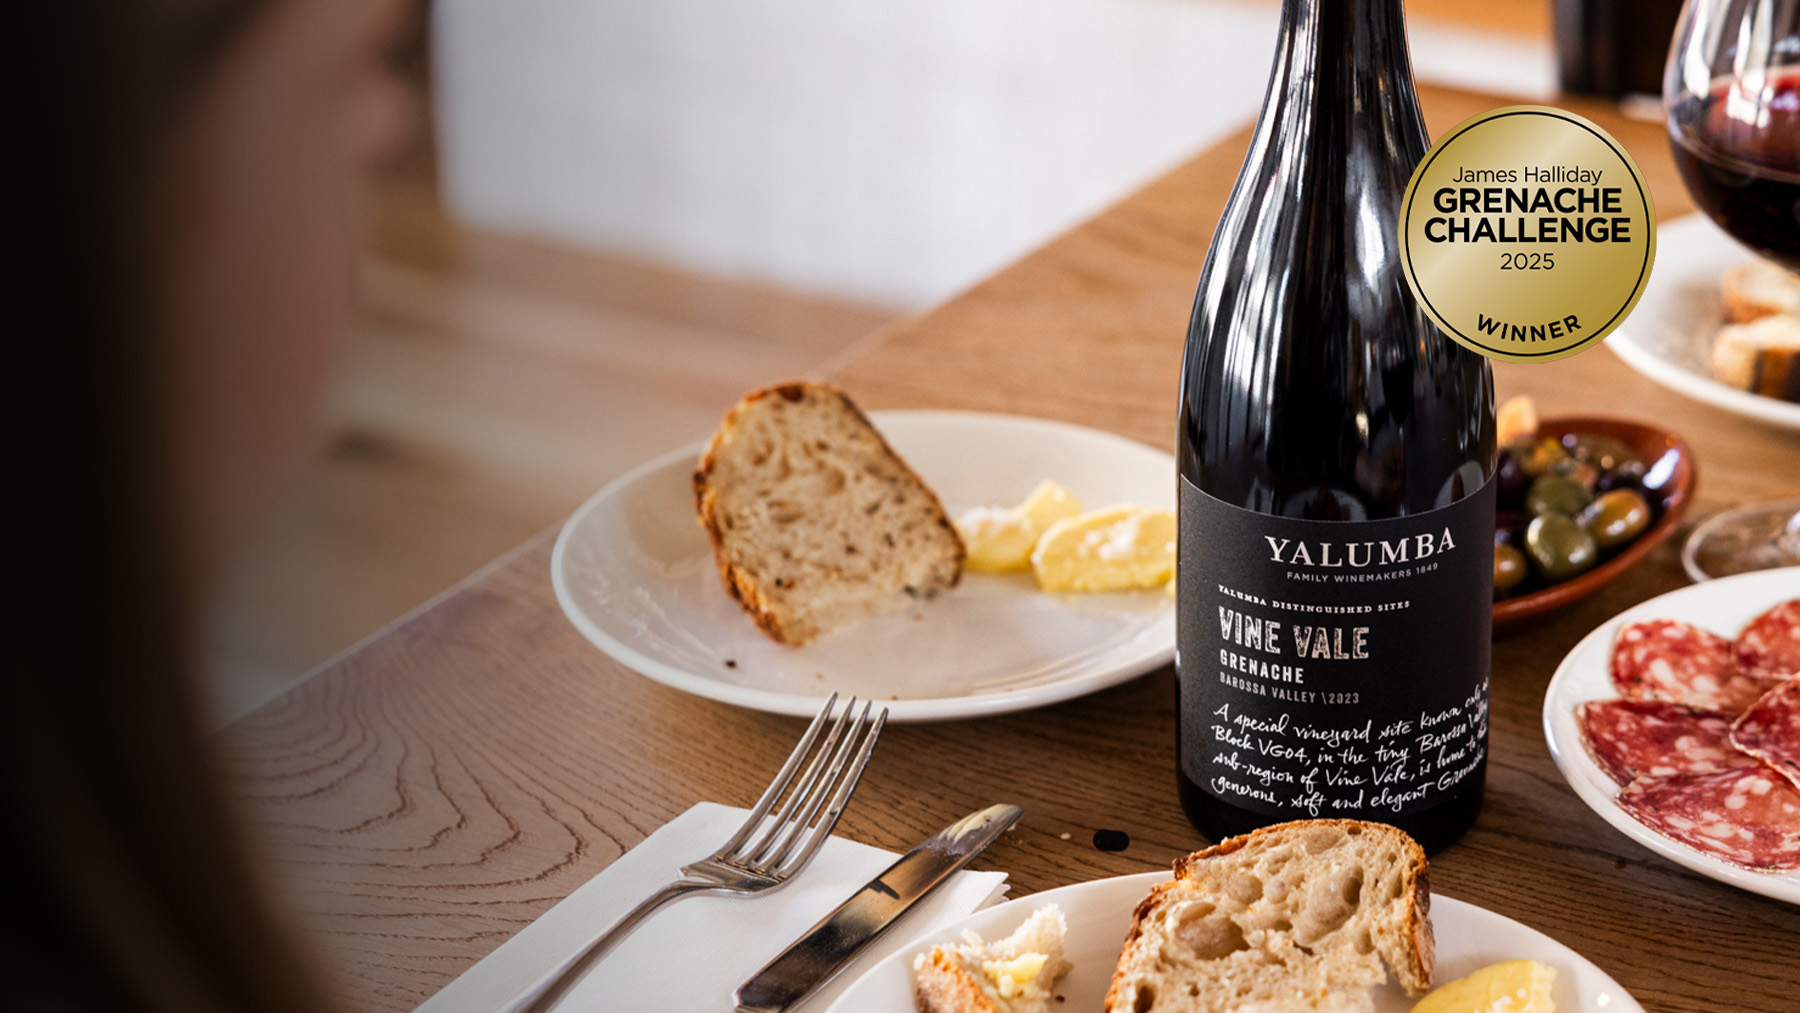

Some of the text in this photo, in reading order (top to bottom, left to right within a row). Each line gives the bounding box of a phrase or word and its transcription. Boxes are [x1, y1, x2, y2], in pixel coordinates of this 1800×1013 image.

[1264, 527, 1456, 568] YALUMBA
[1287, 562, 1438, 583] FAMILY WINEMAKERS 1849
[1218, 584, 1410, 614] YALUMBA DISTINGUISHED SITES
[1218, 605, 1370, 660] VINE VALE
[1220, 648, 1304, 684] GRENACHE
[1220, 671, 1267, 696] BAROSSA
[1271, 686, 1316, 704] VALLEY
[1213, 703, 1229, 721] A
[1234, 713, 1290, 736] special
[1292, 720, 1372, 748] vineyard
[1378, 720, 1413, 740] site
[1420, 707, 1462, 730] known
[1211, 725, 1255, 750] Block
[1318, 747, 1334, 763] in
[1337, 746, 1369, 765] the
[1374, 740, 1411, 771] tiny
[1415, 723, 1467, 754] Barossa
[1213, 735, 1476, 795] sub-region of Vine Vale, is home to
[1211, 776, 1283, 807] generous,
[1291, 792, 1327, 817] soft
[1332, 789, 1364, 809] and
[1370, 782, 1436, 813] elegant
